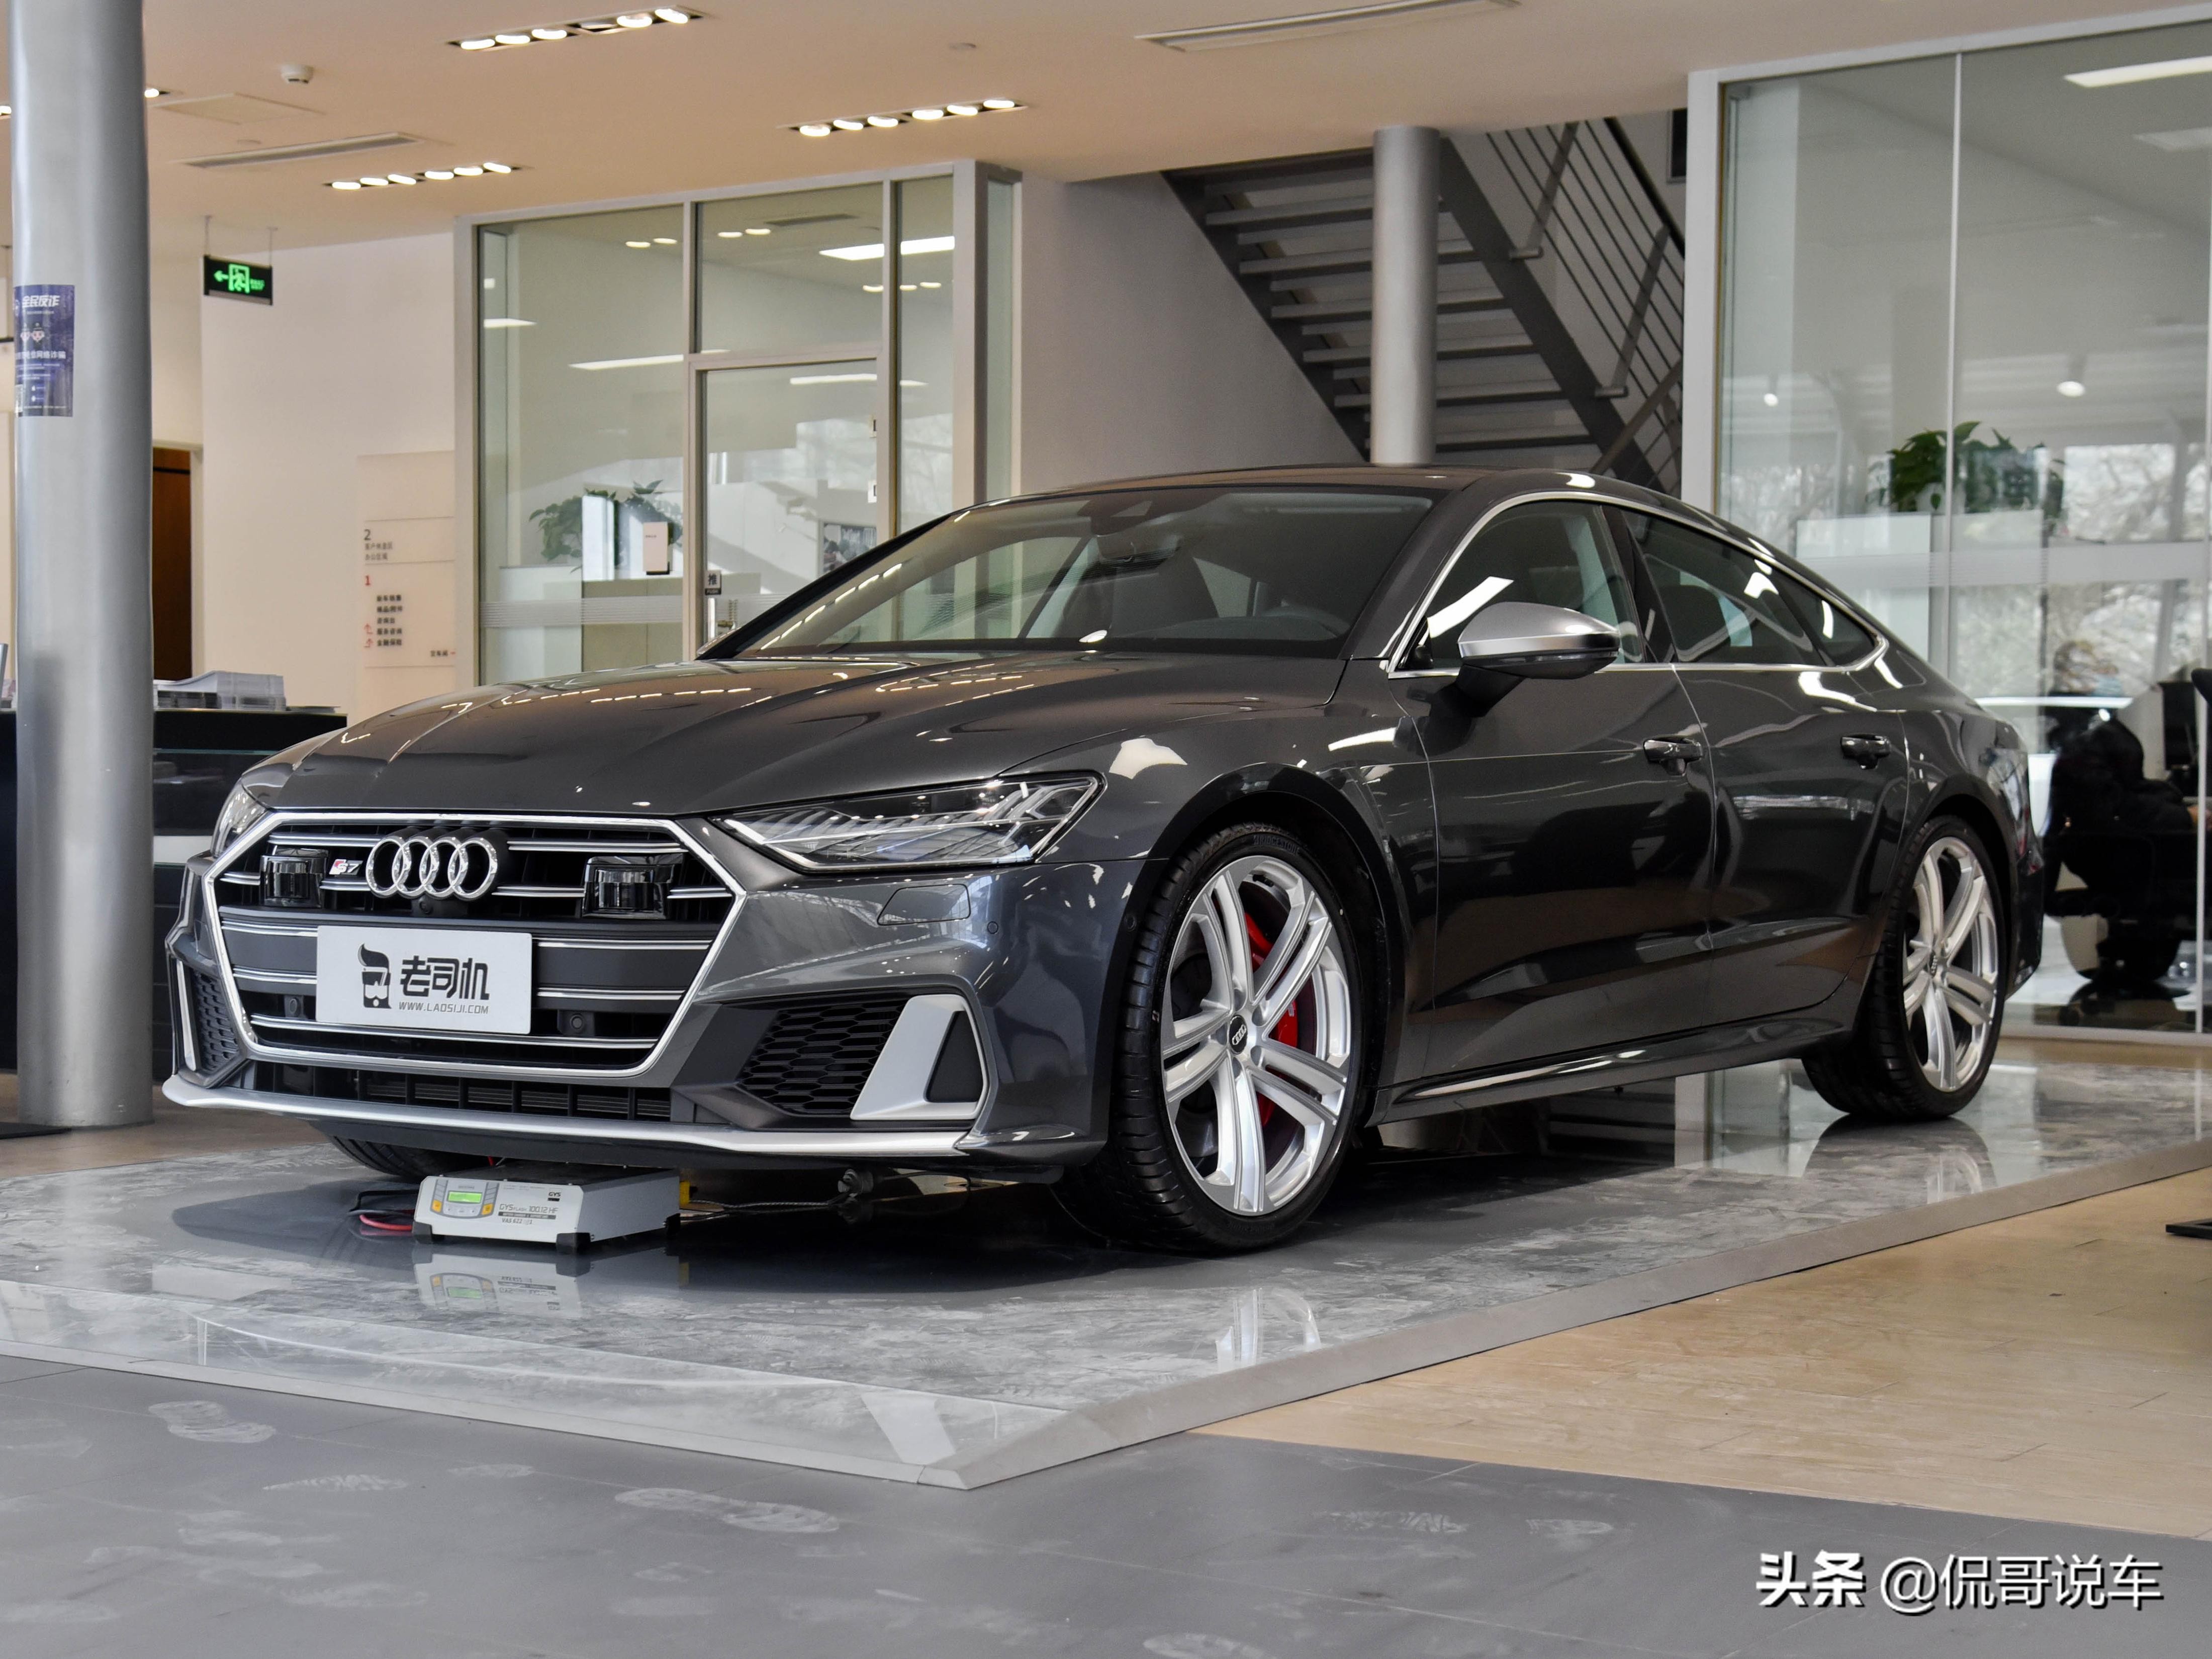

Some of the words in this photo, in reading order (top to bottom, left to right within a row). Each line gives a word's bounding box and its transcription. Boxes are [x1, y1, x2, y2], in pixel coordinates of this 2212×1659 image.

[22, 295, 60, 308] 全民反诈
[364, 529, 371, 540] 2
[365, 575, 371, 586] 1
[708, 573, 717, 585] 推
[333, 861, 361, 875] S7
[400, 956, 490, 1000] 老司机
[399, 1001, 489, 1015] WWW.LAOSIJI.COM
